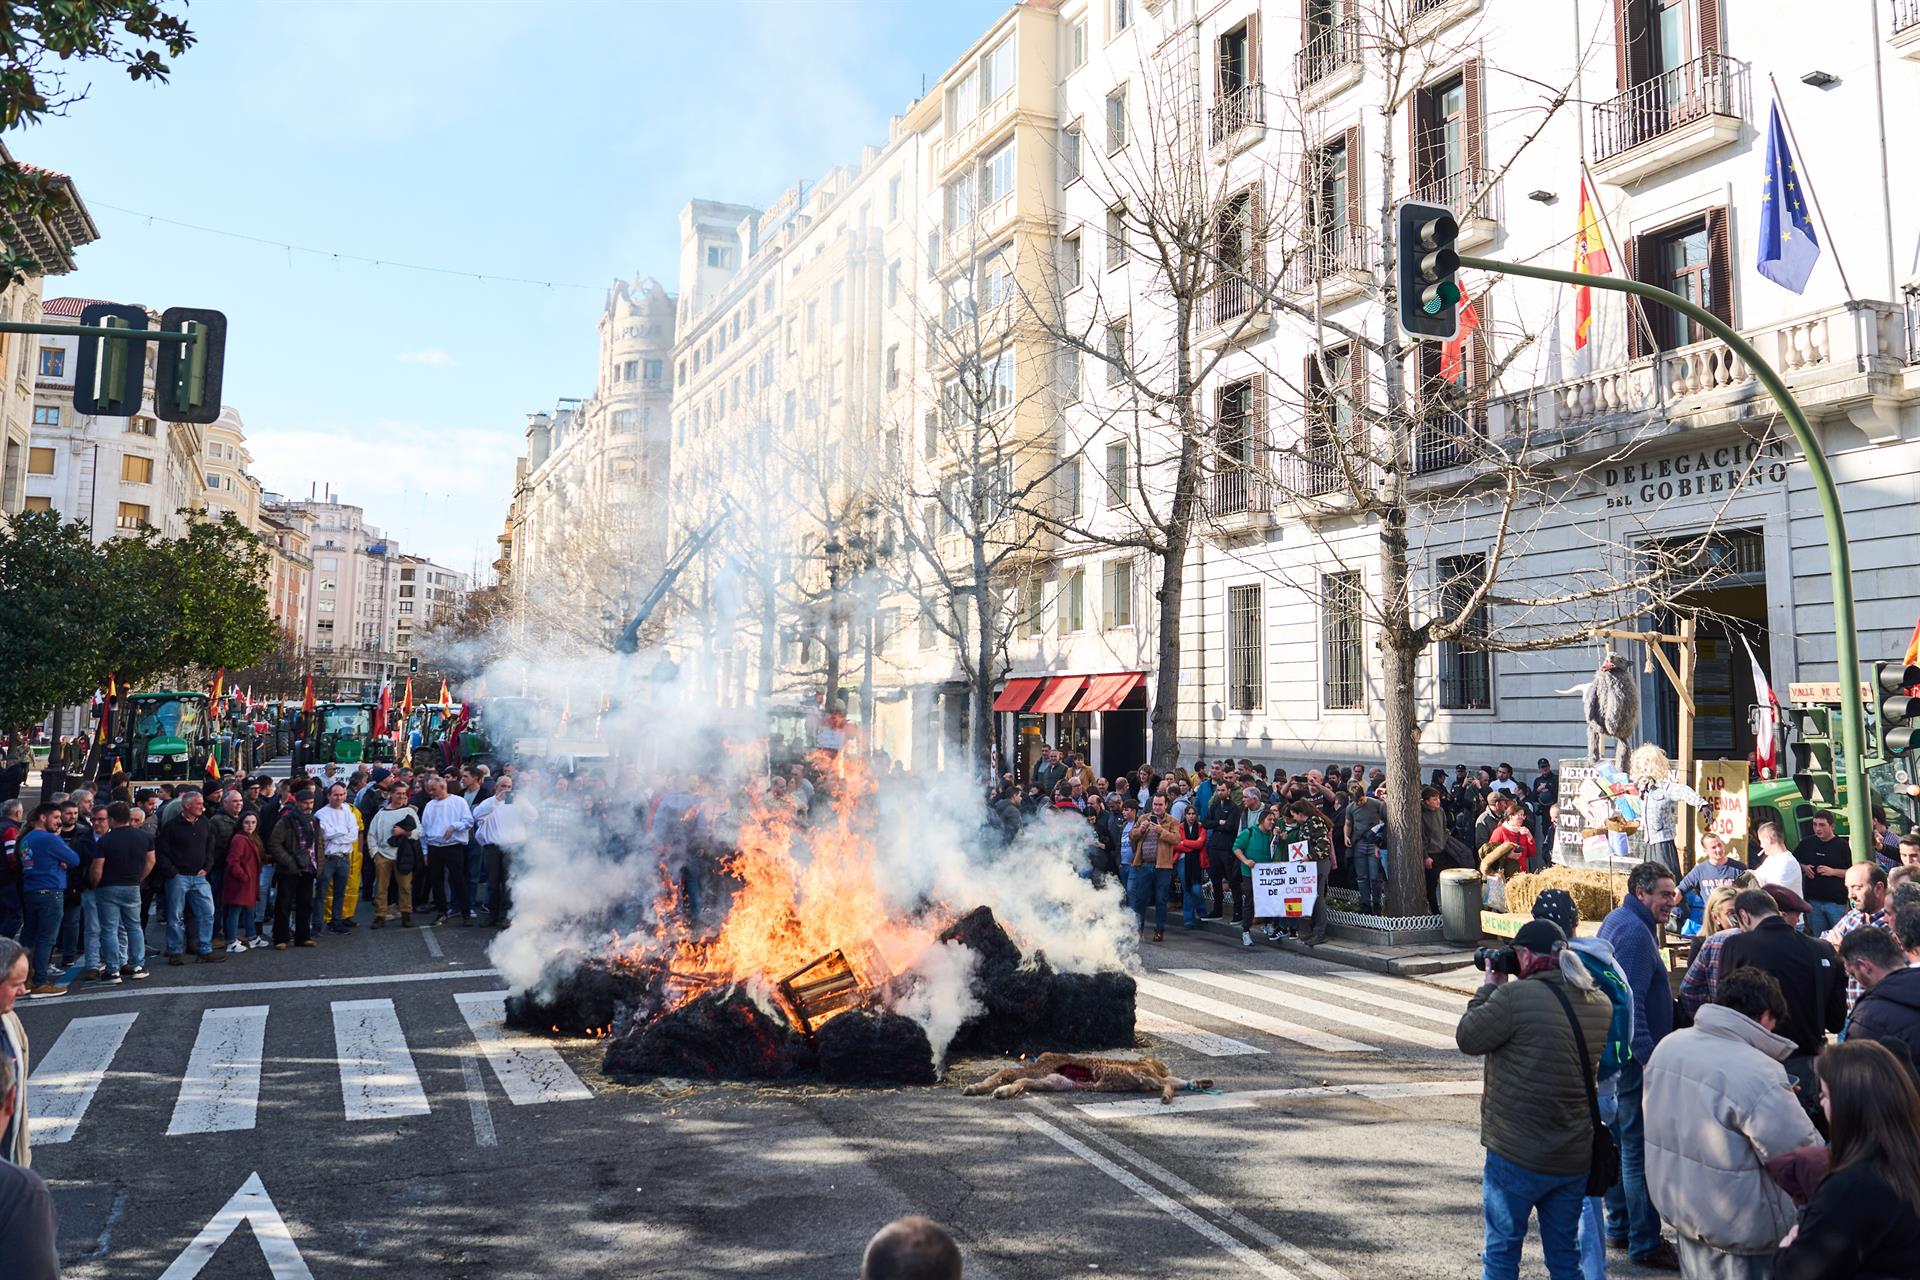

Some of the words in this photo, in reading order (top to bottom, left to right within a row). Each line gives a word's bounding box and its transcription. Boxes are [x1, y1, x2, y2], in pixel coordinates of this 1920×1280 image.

[1607, 495, 1633, 508] DEL
[1640, 462, 1787, 503] GOBIERNO
[1706, 776, 1725, 791] NO
[1703, 796, 1742, 813] GENDA
[1560, 814, 1580, 827] VON
